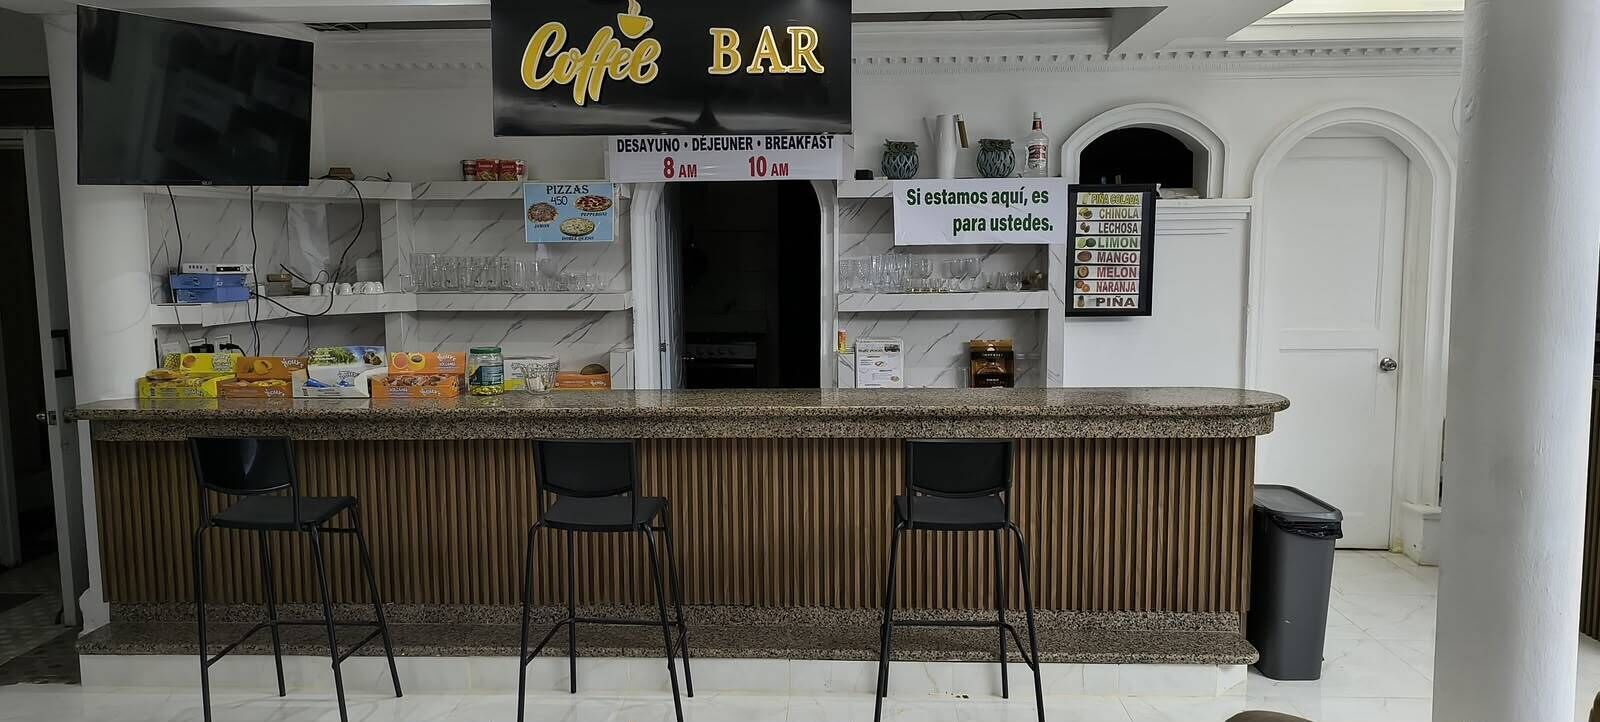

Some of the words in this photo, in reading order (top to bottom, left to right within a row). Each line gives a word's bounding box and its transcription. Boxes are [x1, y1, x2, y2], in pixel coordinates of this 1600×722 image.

[521, 21, 662, 106] Coffee
[708, 26, 825, 75] BAR
[617, 138, 680, 152] DESAYUNO
[692, 135, 753, 152] DÉJEUNER
[765, 135, 834, 150] BREAKFAST
[663, 157, 674, 178] 8
[679, 164, 697, 178] AM
[748, 156, 767, 177] 10
[771, 163, 789, 177] AM
[546, 184, 589, 195] PIZZAS
[551, 195, 568, 206] 450
[906, 188, 921, 205] Si
[924, 189, 988, 205] estamos
[991, 186, 1028, 208] aquí,
[1031, 189, 1049, 204] es
[1091, 192, 1109, 204] PIÑA
[1110, 193, 1139, 205] COLADA
[1099, 208, 1139, 219] CHINOLA
[953, 216, 986, 236] para
[990, 213, 1053, 231] ustedes.
[1098, 222, 1138, 233] LECHOSA
[1097, 252, 1137, 263] MANGO
[1096, 266, 1137, 277] MELON
[1096, 281, 1136, 293] NARANJA
[1095, 295, 1135, 307] PIÑA
